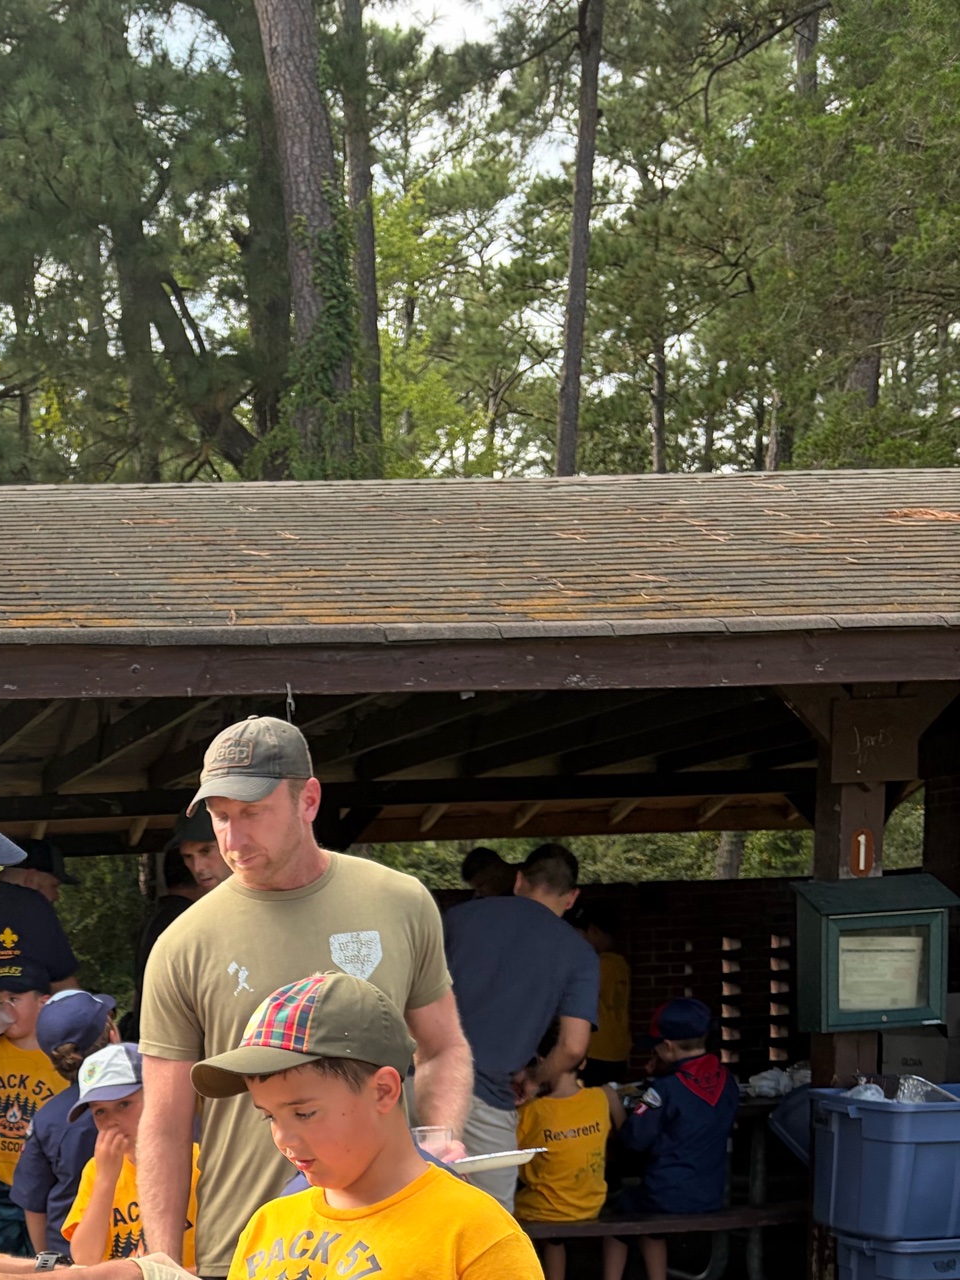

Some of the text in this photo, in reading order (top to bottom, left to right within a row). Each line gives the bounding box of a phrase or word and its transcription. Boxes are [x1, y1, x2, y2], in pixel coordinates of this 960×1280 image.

[856, 833, 866, 870] 1
[344, 953, 373, 965] BRAVE
[32, 1080, 55, 1101] 57
[543, 1121, 601, 1142] Reverent
[0, 1141, 25, 1152] SCO
[113, 1202, 139, 1227] AC
[245, 1230, 342, 1280] PACK
